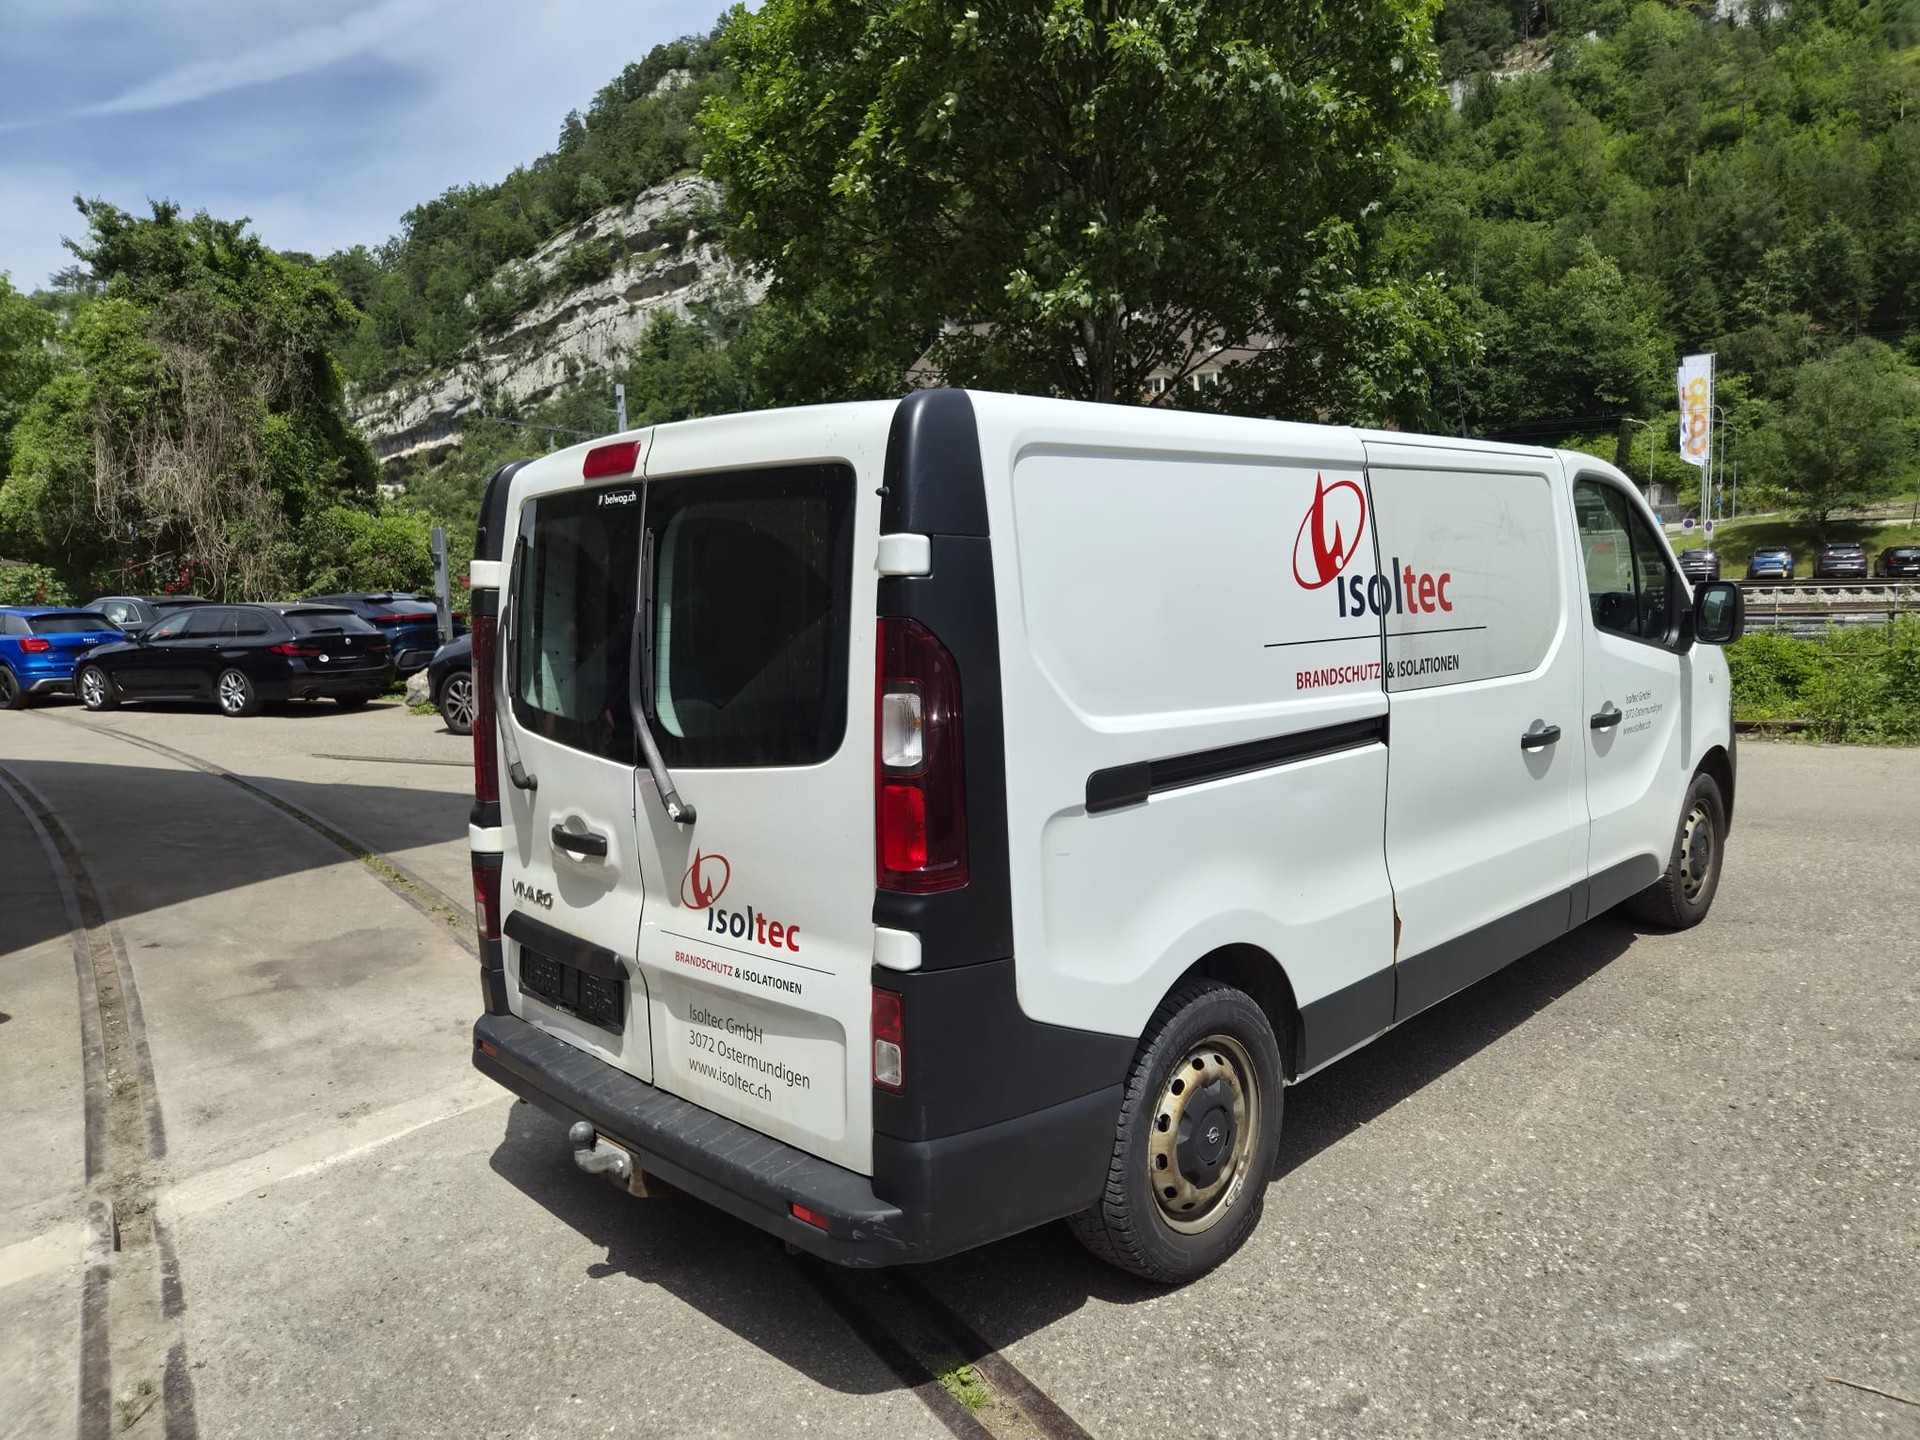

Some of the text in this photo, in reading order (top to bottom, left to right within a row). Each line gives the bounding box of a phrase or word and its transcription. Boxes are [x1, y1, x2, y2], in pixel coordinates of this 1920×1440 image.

[604, 490, 636, 504] belwag.ch
[1337, 557, 1453, 618] isoltec
[1296, 655, 1459, 690] BRANDSCHUTZ & ISOLATIONEN
[512, 878, 554, 910] VIVARO
[707, 905, 800, 953] isoltec
[675, 951, 802, 995] BRANDSCHUTZ & ISOLATIONEN
[689, 1004, 763, 1044] Isoltec GmbH
[689, 1030, 810, 1089] 3072 Ostermundigen
[689, 1058, 772, 1102] www.isoltec.ch
